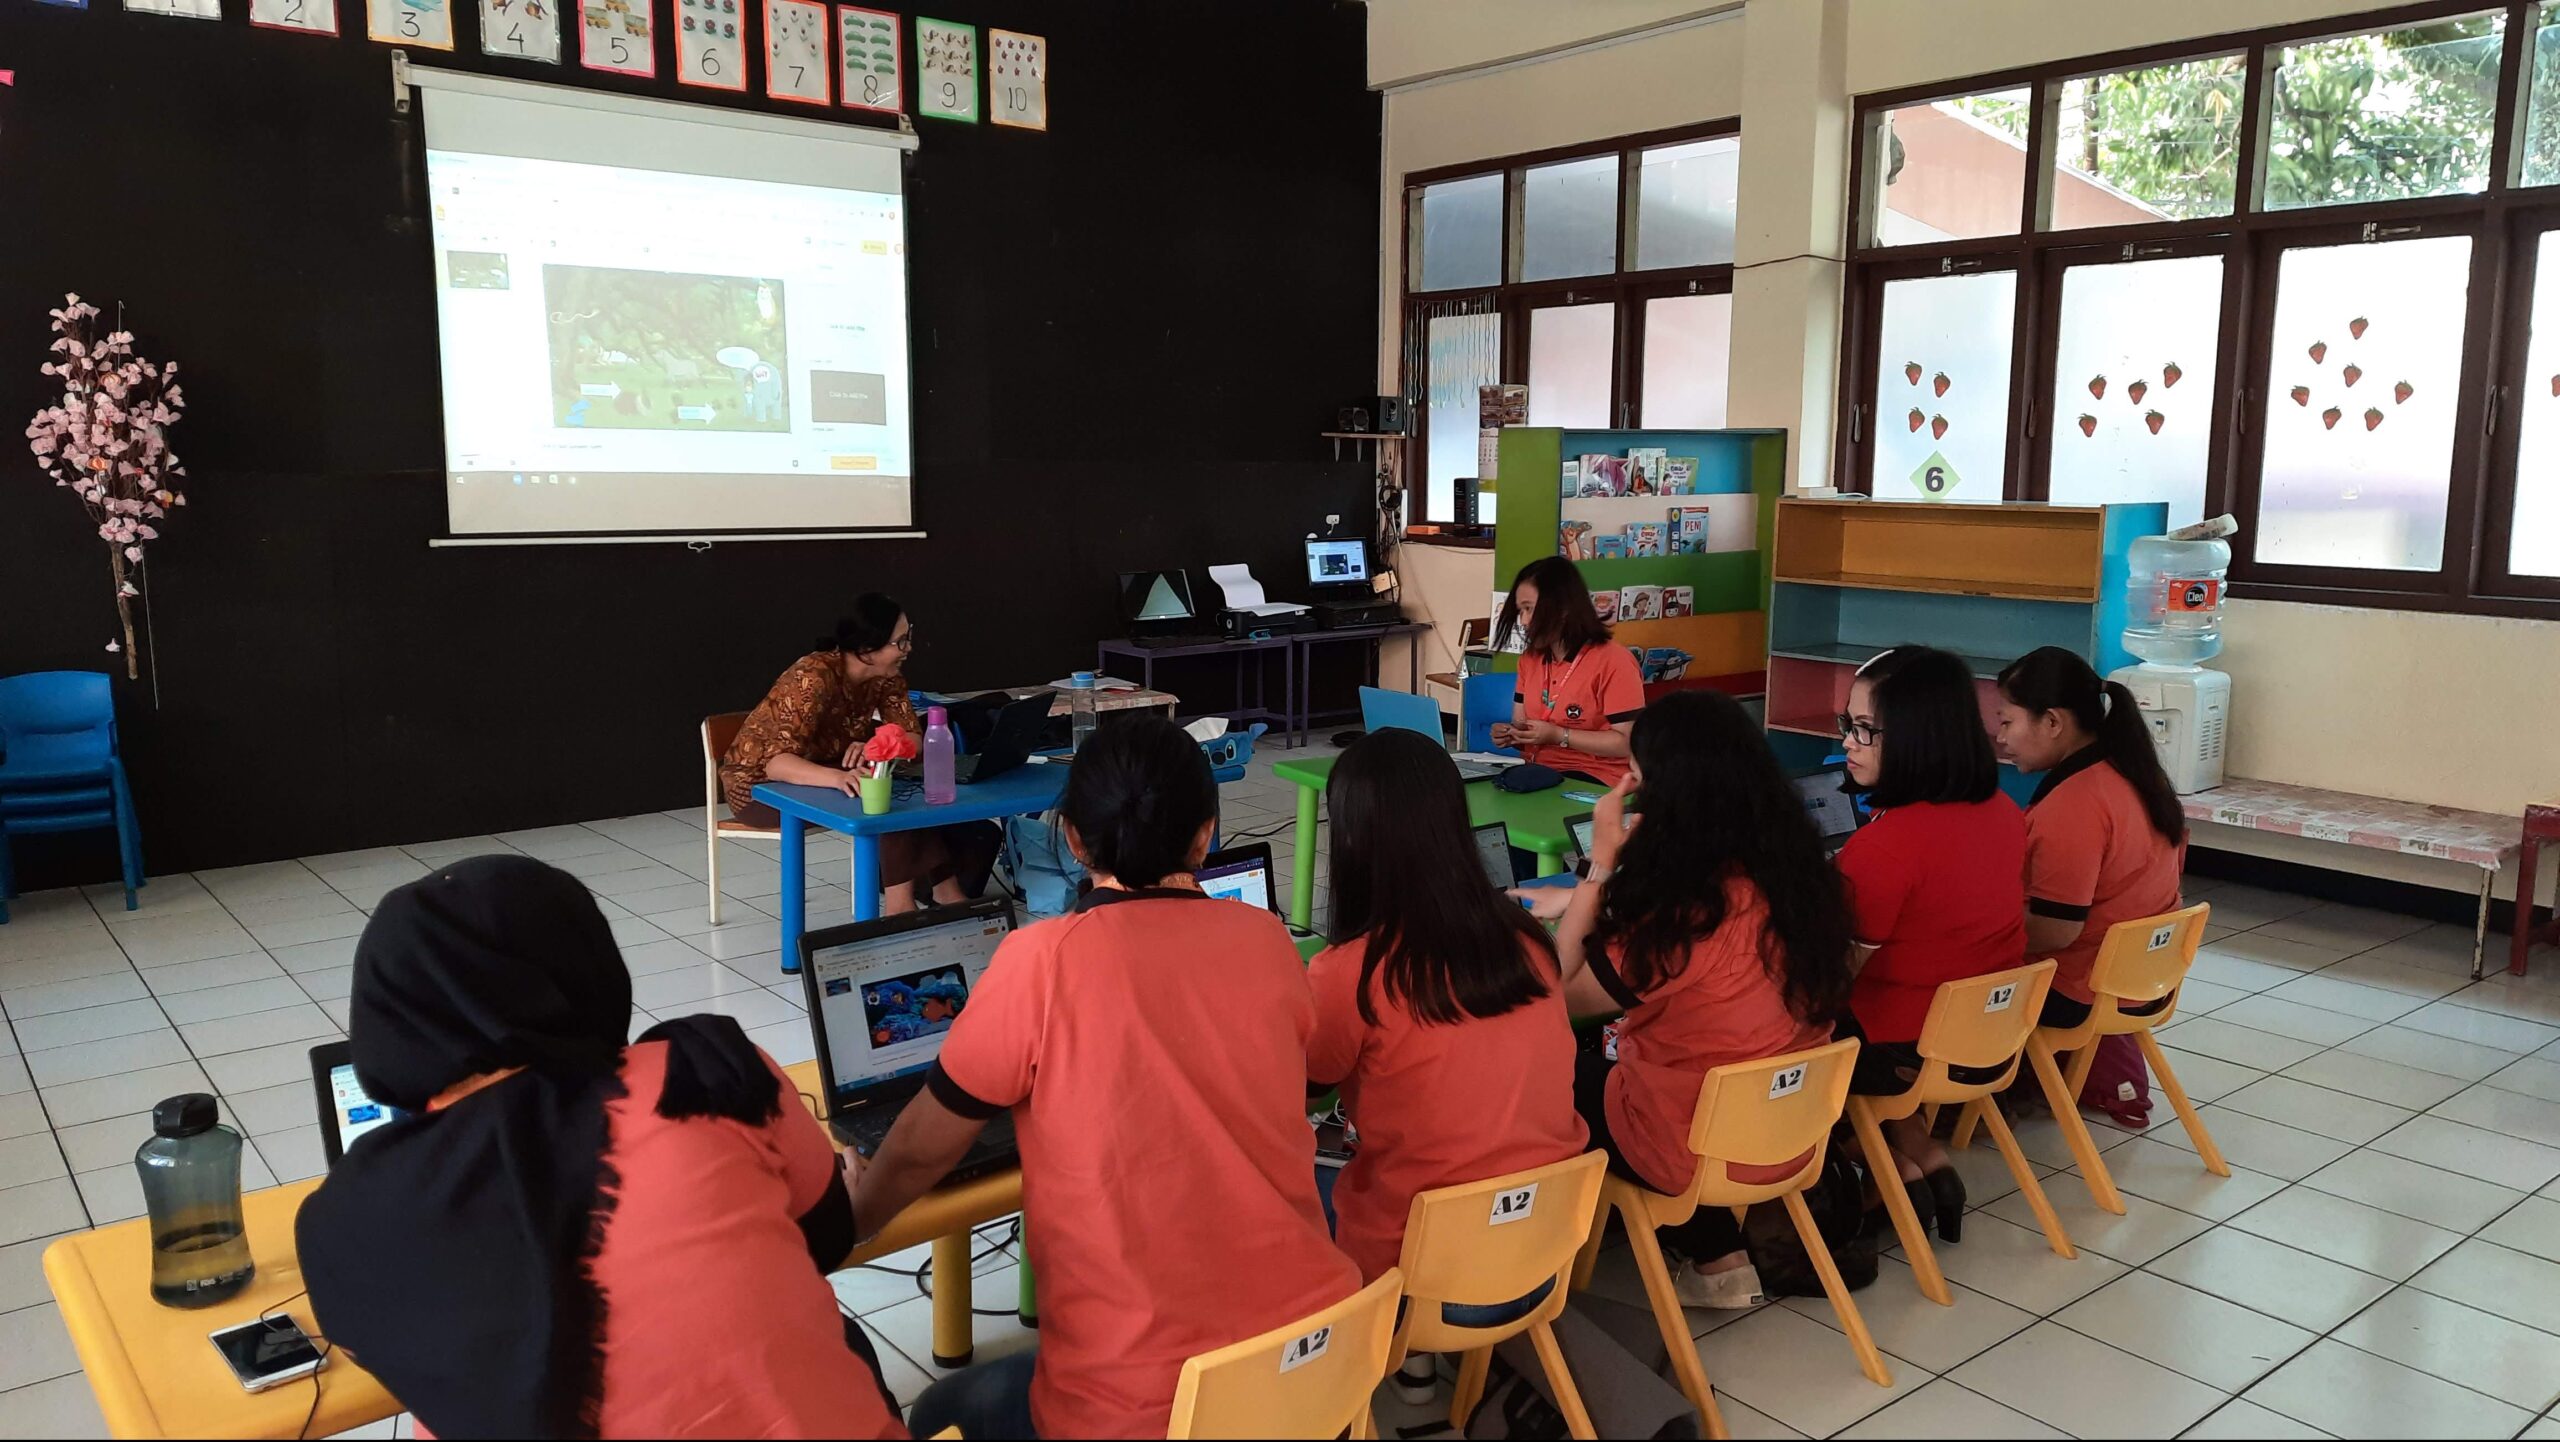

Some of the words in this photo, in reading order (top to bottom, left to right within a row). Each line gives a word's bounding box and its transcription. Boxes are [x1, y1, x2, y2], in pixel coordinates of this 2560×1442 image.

[400, 11, 421, 37] 3
[506, 22, 525, 53] 4
[610, 37, 629, 64] 5
[701, 48, 721, 76] 6
[788, 65, 805, 88] 7
[863, 75, 878, 105] 8
[941, 82, 957, 108] 9
[1008, 86, 1028, 112] 10
[1925, 466, 1945, 493] 6
[2186, 591, 2204, 602] Cleo
[2149, 931, 2171, 948] A2
[1987, 988, 2012, 1006] A2
[1771, 1069, 1802, 1092] A2
[1492, 1191, 1531, 1216] A2
[1287, 1327, 1330, 1363] A2
